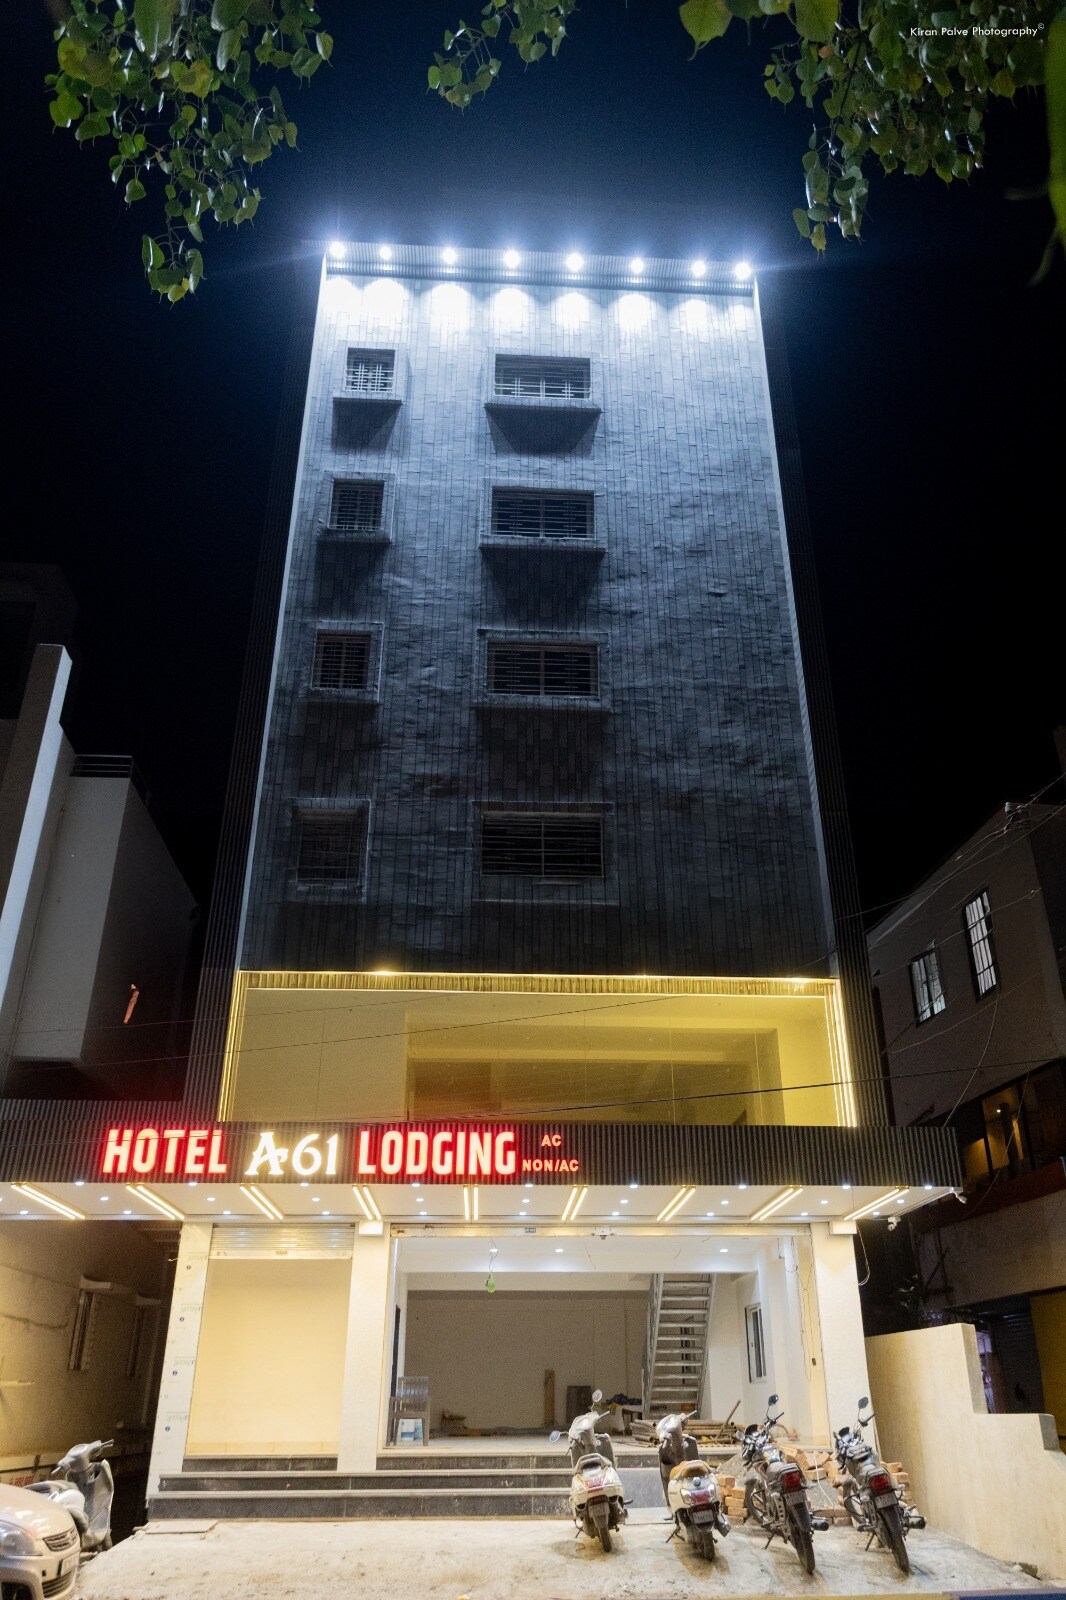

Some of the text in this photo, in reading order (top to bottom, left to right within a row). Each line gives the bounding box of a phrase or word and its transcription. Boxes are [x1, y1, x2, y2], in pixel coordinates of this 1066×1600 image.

[541, 1134, 562, 1147] AC
[102, 1128, 227, 1174] HOTEL
[358, 1130, 516, 1175] LODGING
[522, 1159, 579, 1172] NON/AC
